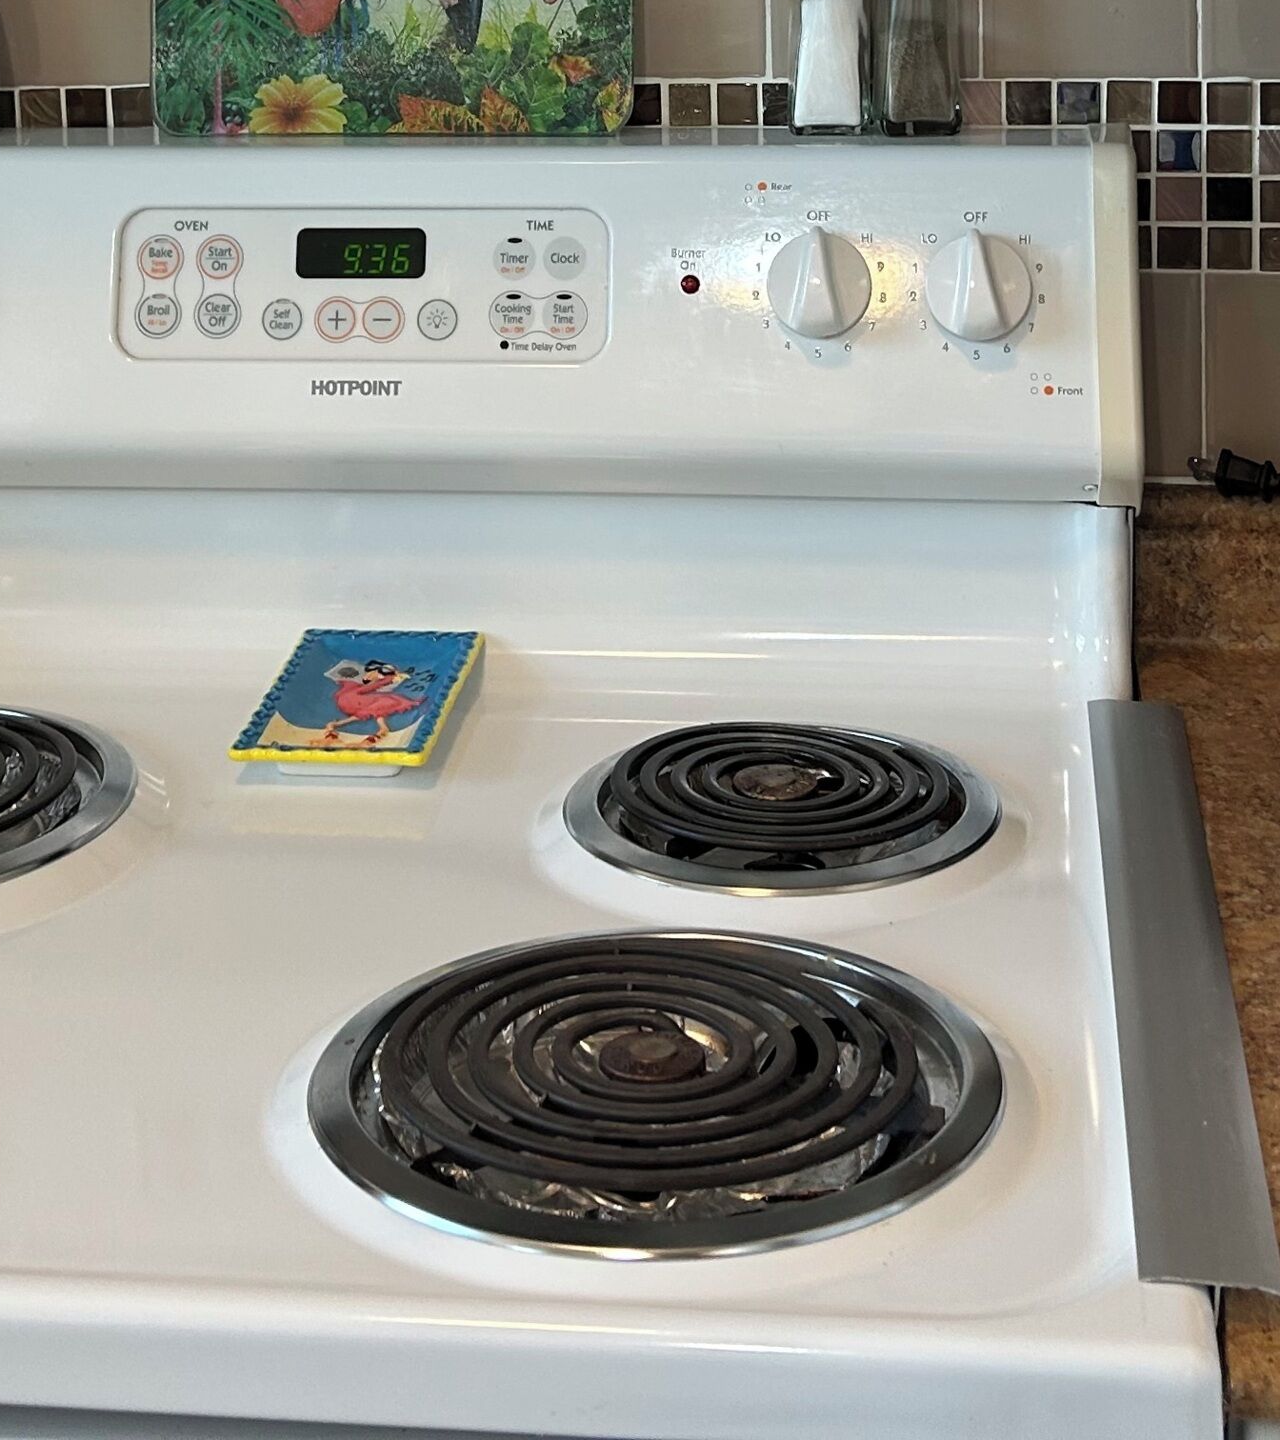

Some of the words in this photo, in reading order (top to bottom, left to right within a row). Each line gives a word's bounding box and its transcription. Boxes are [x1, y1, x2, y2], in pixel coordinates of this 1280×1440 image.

[770, 182, 792, 191] Rear
[807, 210, 831, 222] OFF
[963, 211, 988, 223] OFF
[174, 220, 209, 231] OVEN
[526, 220, 555, 231] TIME
[765, 232, 782, 243] LO
[861, 233, 874, 244] HI
[921, 233, 938, 244] LO
[1019, 234, 1032, 245] HI
[148, 247, 173, 258] Bake
[208, 246, 232, 257] Start
[671, 248, 706, 258] Burner
[343, 244, 411, 274] 9:36
[500, 252, 529, 264] Timer
[550, 252, 580, 264] Clock
[211, 261, 228, 271] On
[680, 261, 696, 271] On
[877, 261, 885, 273] 9
[1035, 263, 1043, 273] 9
[752, 290, 760, 301] 2
[879, 292, 887, 304] 8
[909, 290, 917, 302] 2
[1037, 293, 1046, 304] 8
[147, 305, 170, 316] Broil
[205, 302, 231, 313] Clear
[494, 303, 532, 316] Cooking
[553, 303, 575, 314] Start
[273, 309, 291, 319] Self
[502, 314, 524, 324] Time
[553, 314, 574, 324] Time
[208, 316, 227, 327] Off
[269, 320, 294, 330] Clean
[762, 319, 770, 330] 3
[869, 321, 876, 332] 7
[920, 320, 927, 331] 3
[1028, 322, 1035, 333] 7
[511, 342, 529, 351] Time
[531, 342, 554, 352] Delay
[555, 342, 577, 351] Oven
[784, 341, 791, 351] 4
[844, 342, 852, 353] 6
[942, 342, 949, 352] 4
[1003, 343, 1011, 354] 6
[814, 349, 822, 359] 5
[973, 349, 981, 360] 5
[311, 380, 402, 396] HOTPOINT
[1057, 387, 1083, 396] Front
